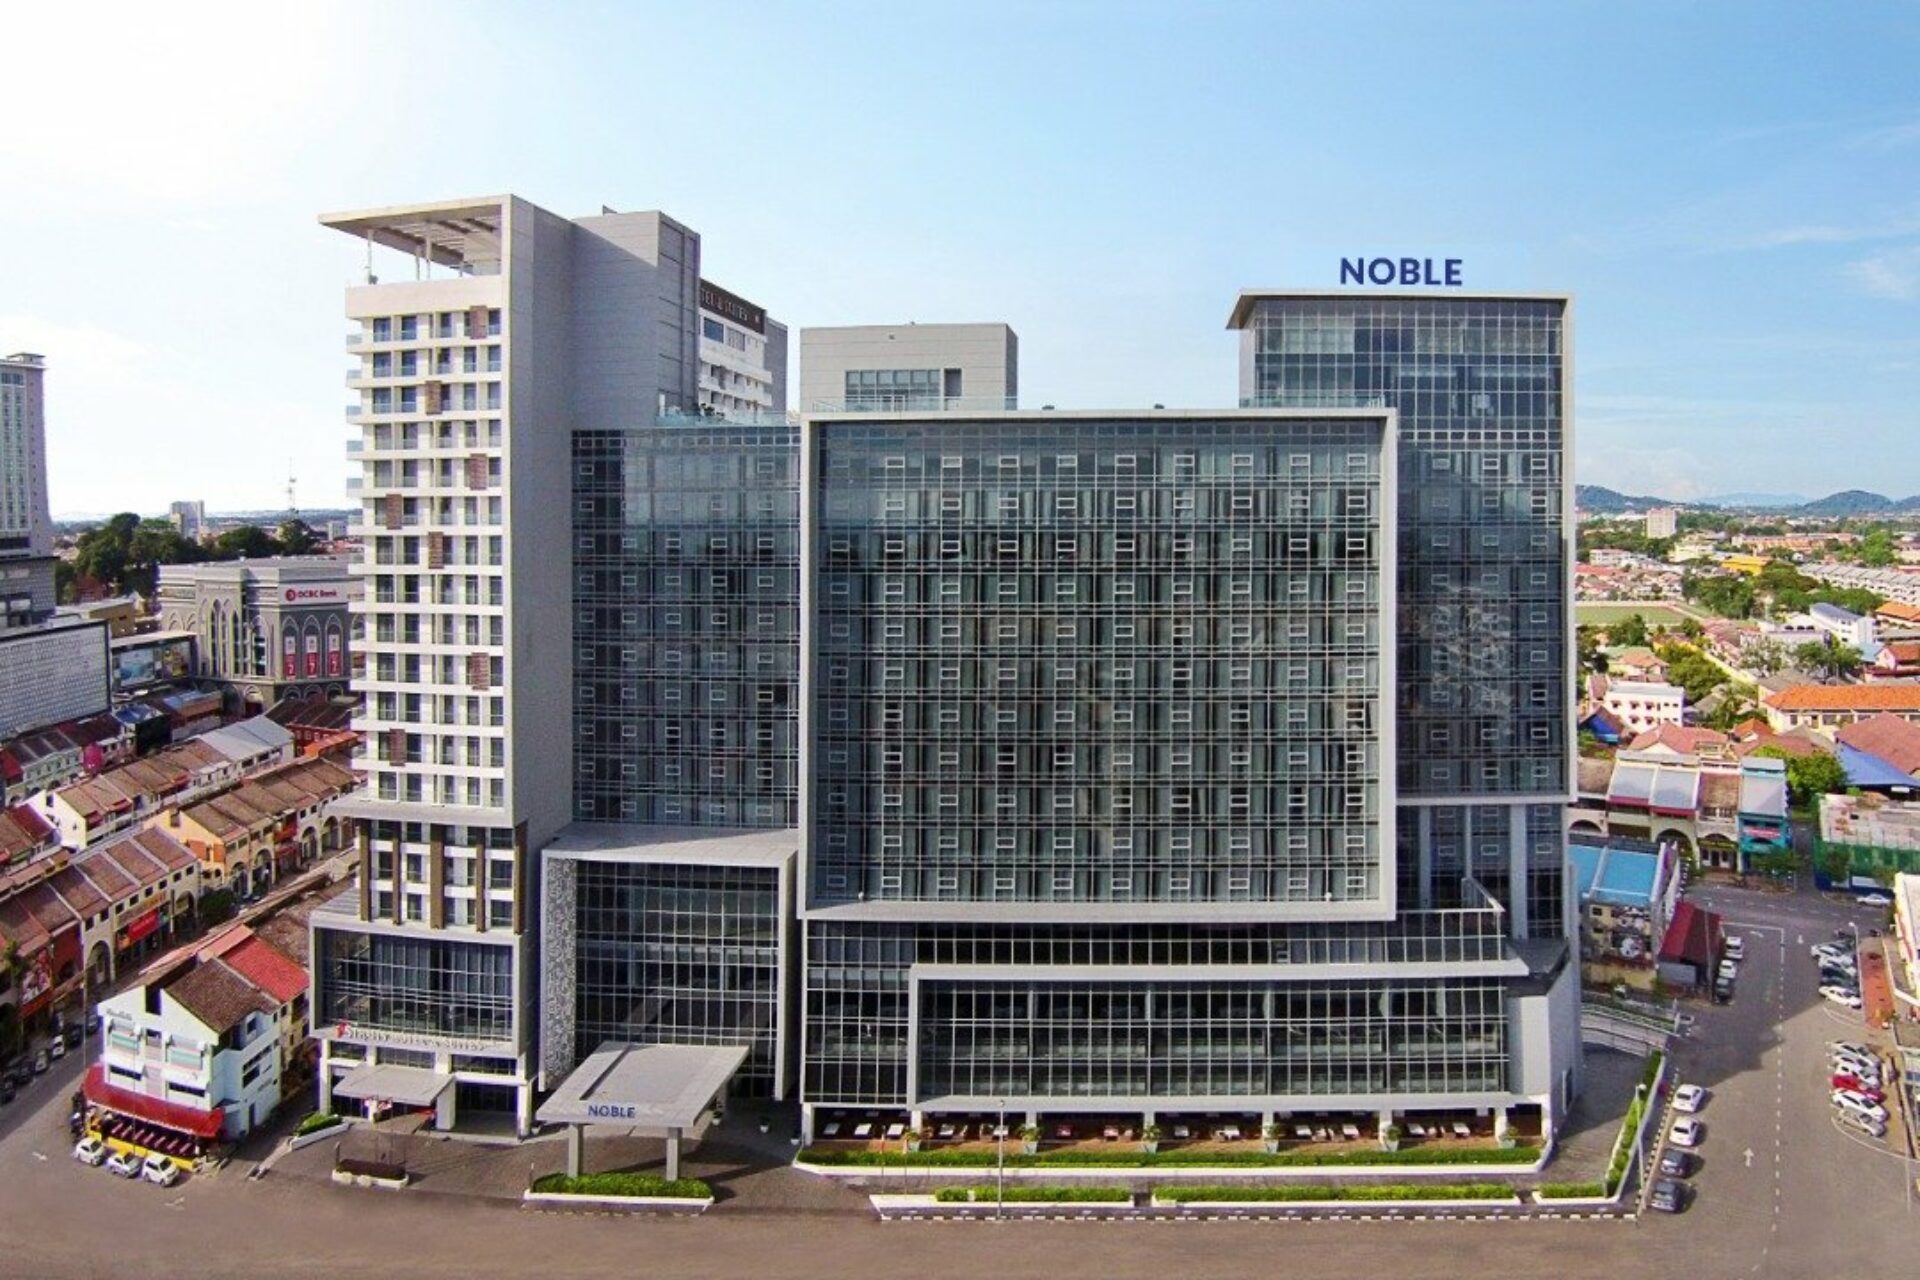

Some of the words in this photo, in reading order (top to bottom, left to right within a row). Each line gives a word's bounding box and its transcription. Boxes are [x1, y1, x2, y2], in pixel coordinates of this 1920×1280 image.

[1340, 257, 1463, 286] NOBLE
[298, 589, 319, 598] OCBC
[320, 589, 337, 598] Bank
[588, 1105, 636, 1119] NOBLE
